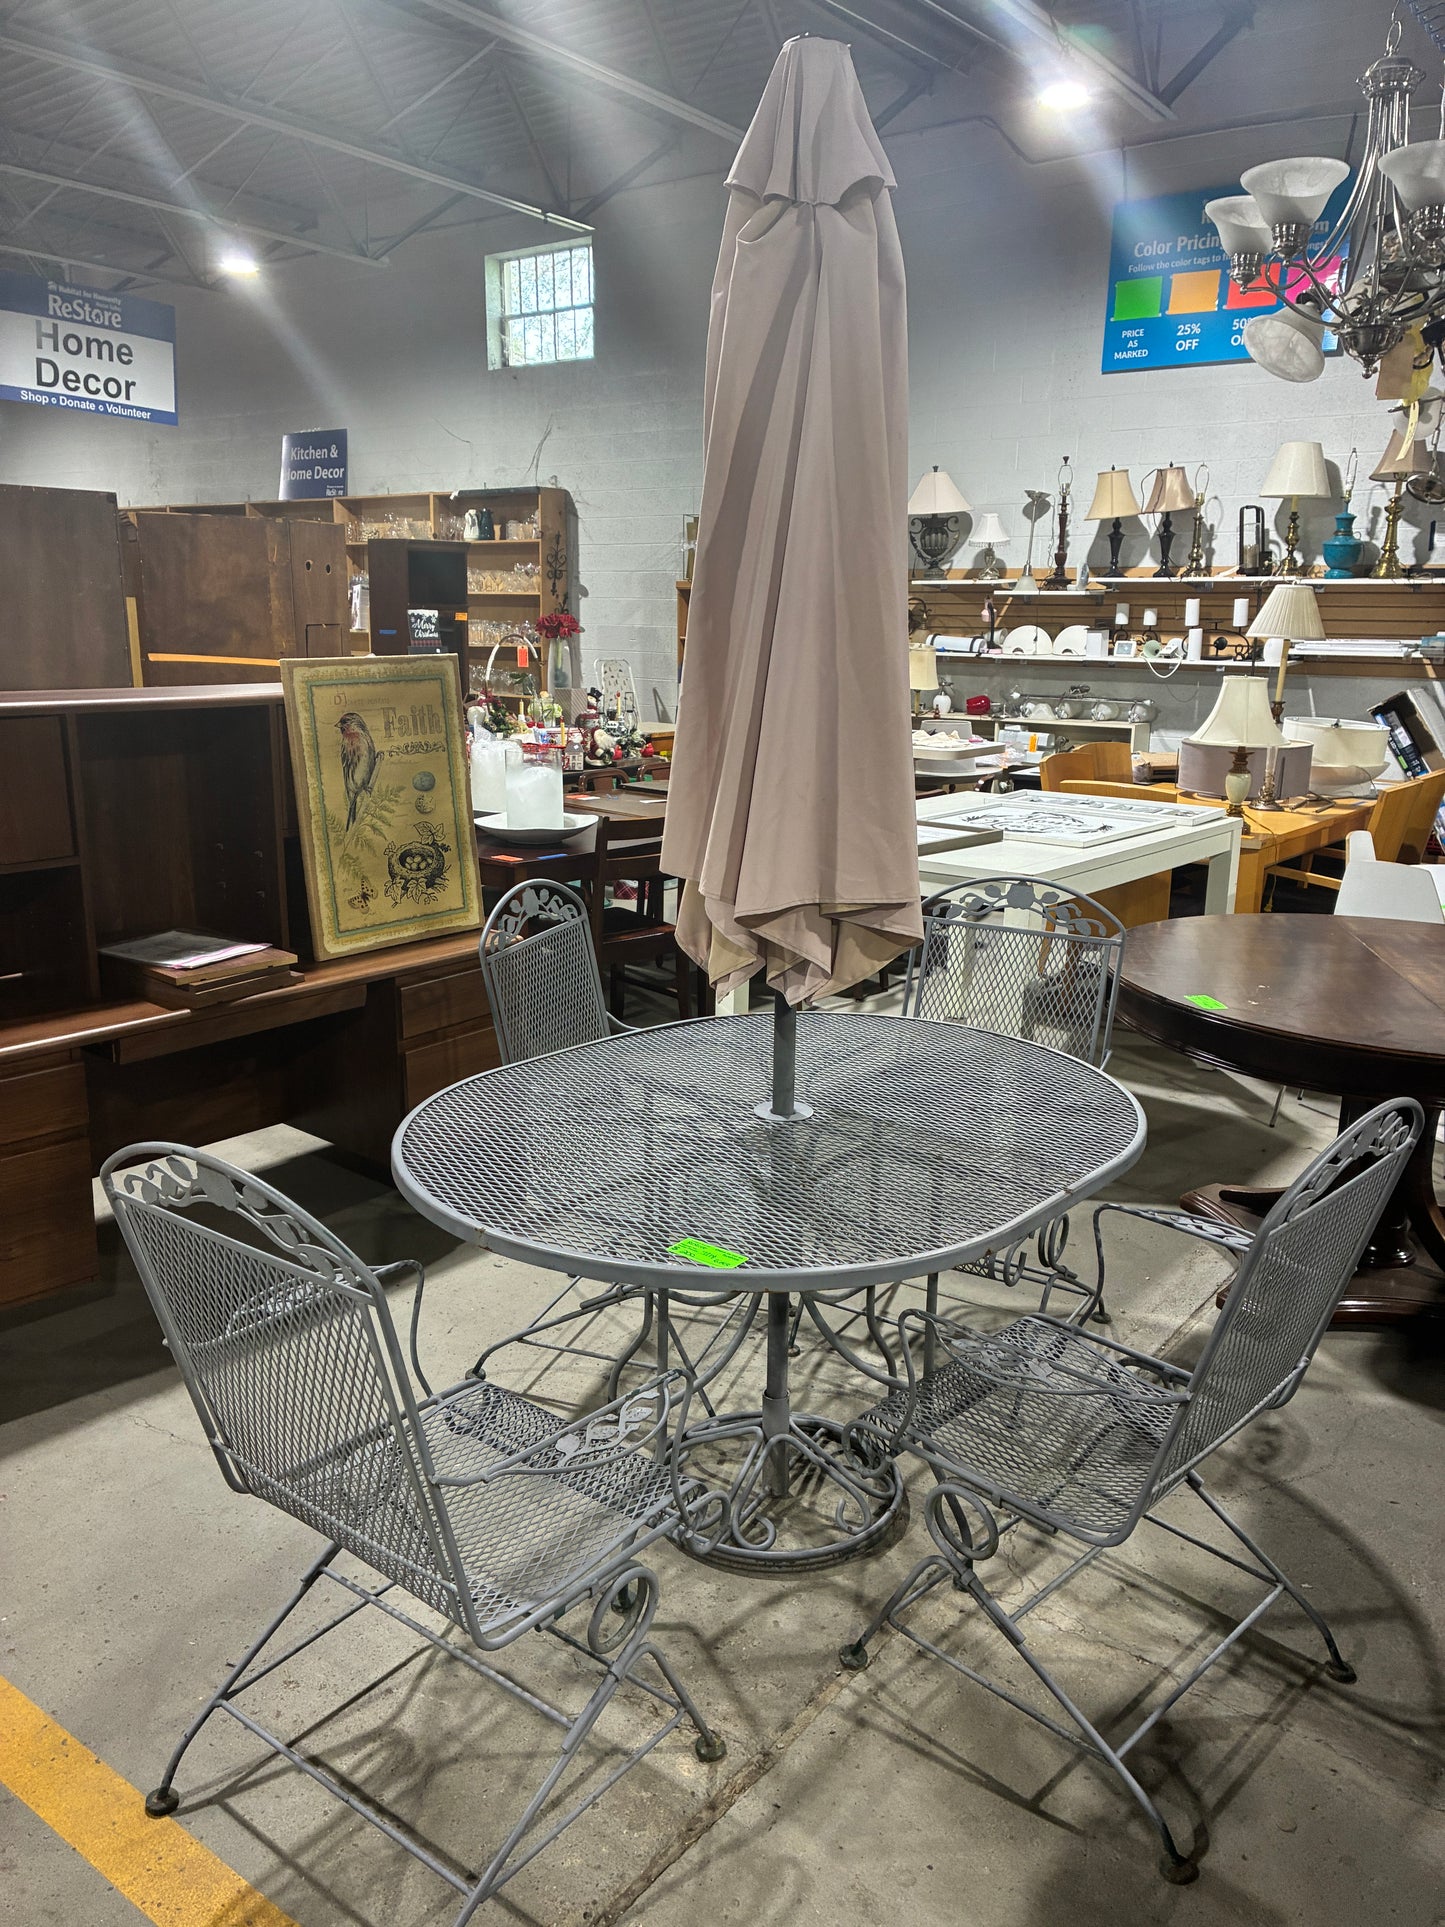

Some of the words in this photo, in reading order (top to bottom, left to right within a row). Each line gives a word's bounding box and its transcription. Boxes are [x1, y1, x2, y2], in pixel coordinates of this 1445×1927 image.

[1134, 241, 1172, 258] Color
[1177, 233, 1223, 252] Pricin
[1128, 262, 1154, 273] Follow
[1156, 260, 1169, 270] the
[1171, 257, 1191, 268] color
[1193, 255, 1210, 266] tags
[1212, 254, 1221, 262] to
[48, 294, 121, 328] ReStore
[1121, 329, 1144, 339] PRICE
[1177, 323, 1201, 336] 25%
[35, 320, 133, 366] Home
[1127, 340, 1138, 348] AS
[1175, 339, 1199, 351] OFF
[1114, 349, 1148, 360] MARKED
[36, 357, 137, 400] Decor
[20, 390, 49, 405] Shop
[59, 396, 96, 411] Donate
[106, 404, 152, 420] Volunteer
[290, 445, 328, 460] Kitchen
[330, 444, 338, 458] &
[314, 465, 345, 479] Decor
[411, 619, 435, 632] Merry
[382, 705, 442, 738] Faith
